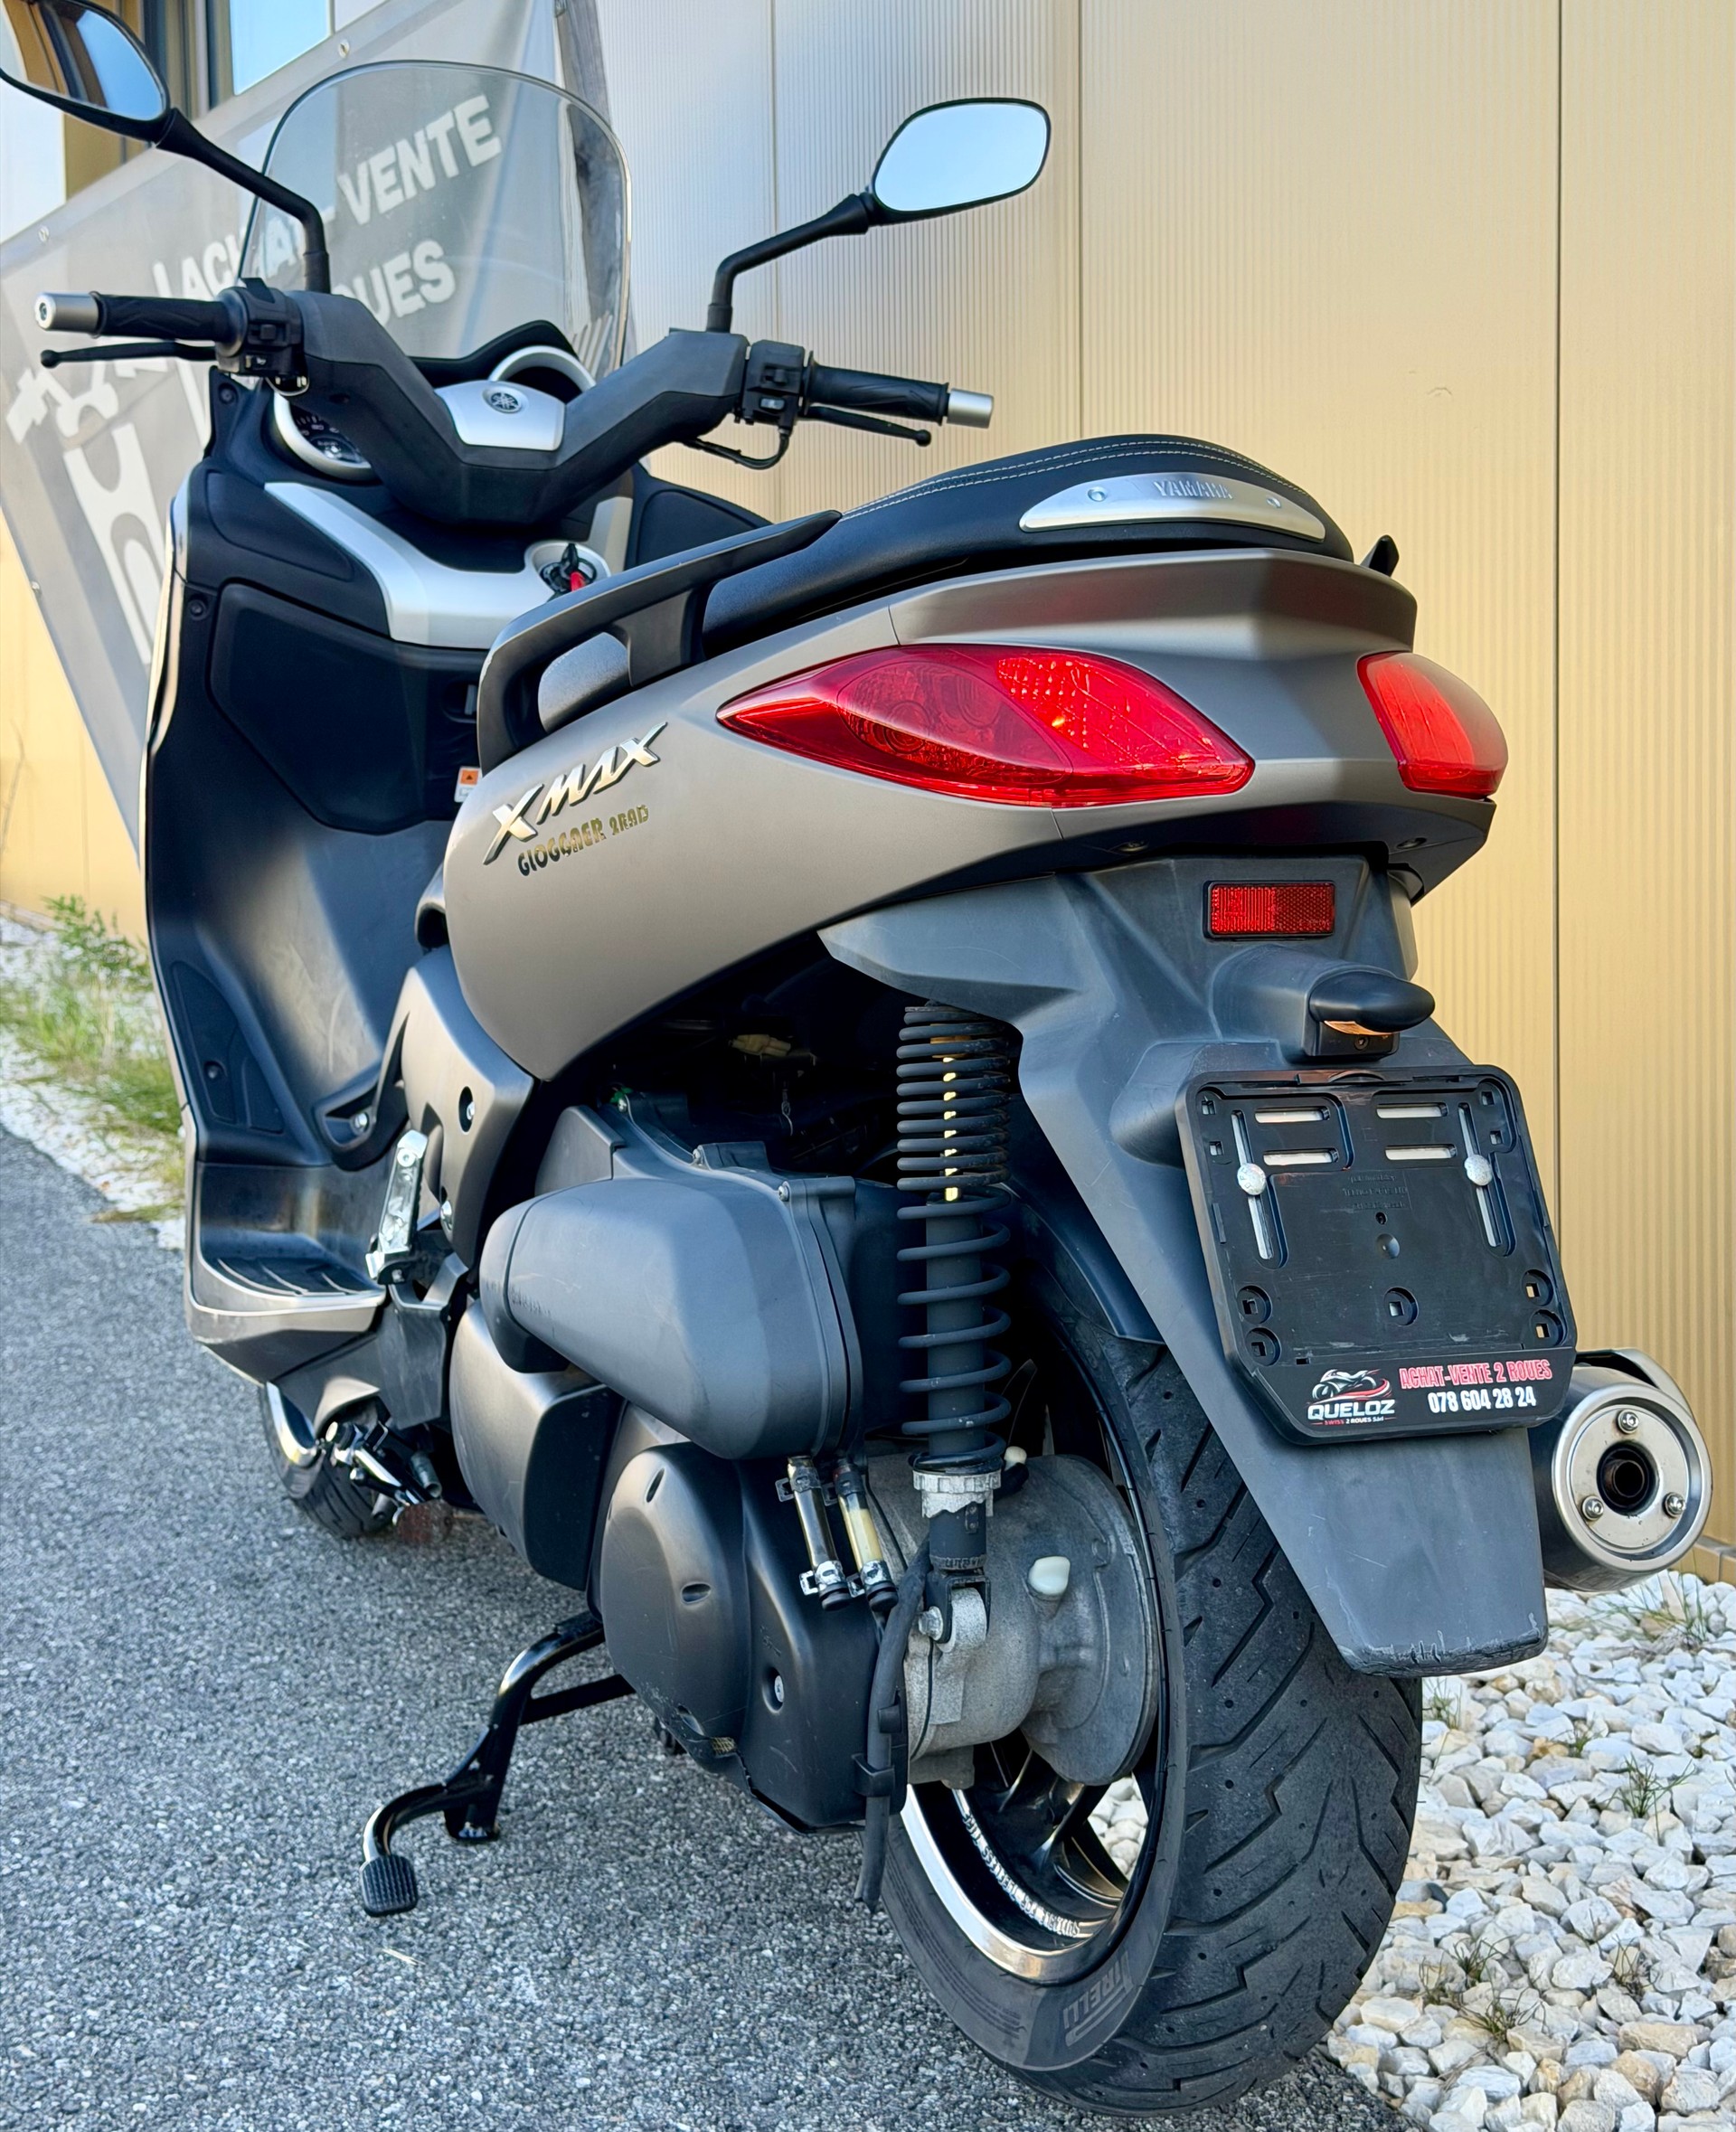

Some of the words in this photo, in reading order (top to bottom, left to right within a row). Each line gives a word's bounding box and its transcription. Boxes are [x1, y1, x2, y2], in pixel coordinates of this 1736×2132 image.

[337, 94, 502, 225] VENTE
[1154, 480, 1233, 500] YAMAHA
[1399, 1363, 1493, 1389] ACHAT-VENTE
[1494, 1362, 1506, 1383] 2
[1506, 1359, 1552, 1382] ROUES
[1307, 1400, 1395, 1420] QUELOZ
[1428, 1391, 1459, 1413] 078
[1460, 1389, 1491, 1410] 604
[1493, 1387, 1514, 1409] 28
[1514, 1386, 1536, 1407] 24
[1063, 1951, 1134, 2046] PIRELLI
